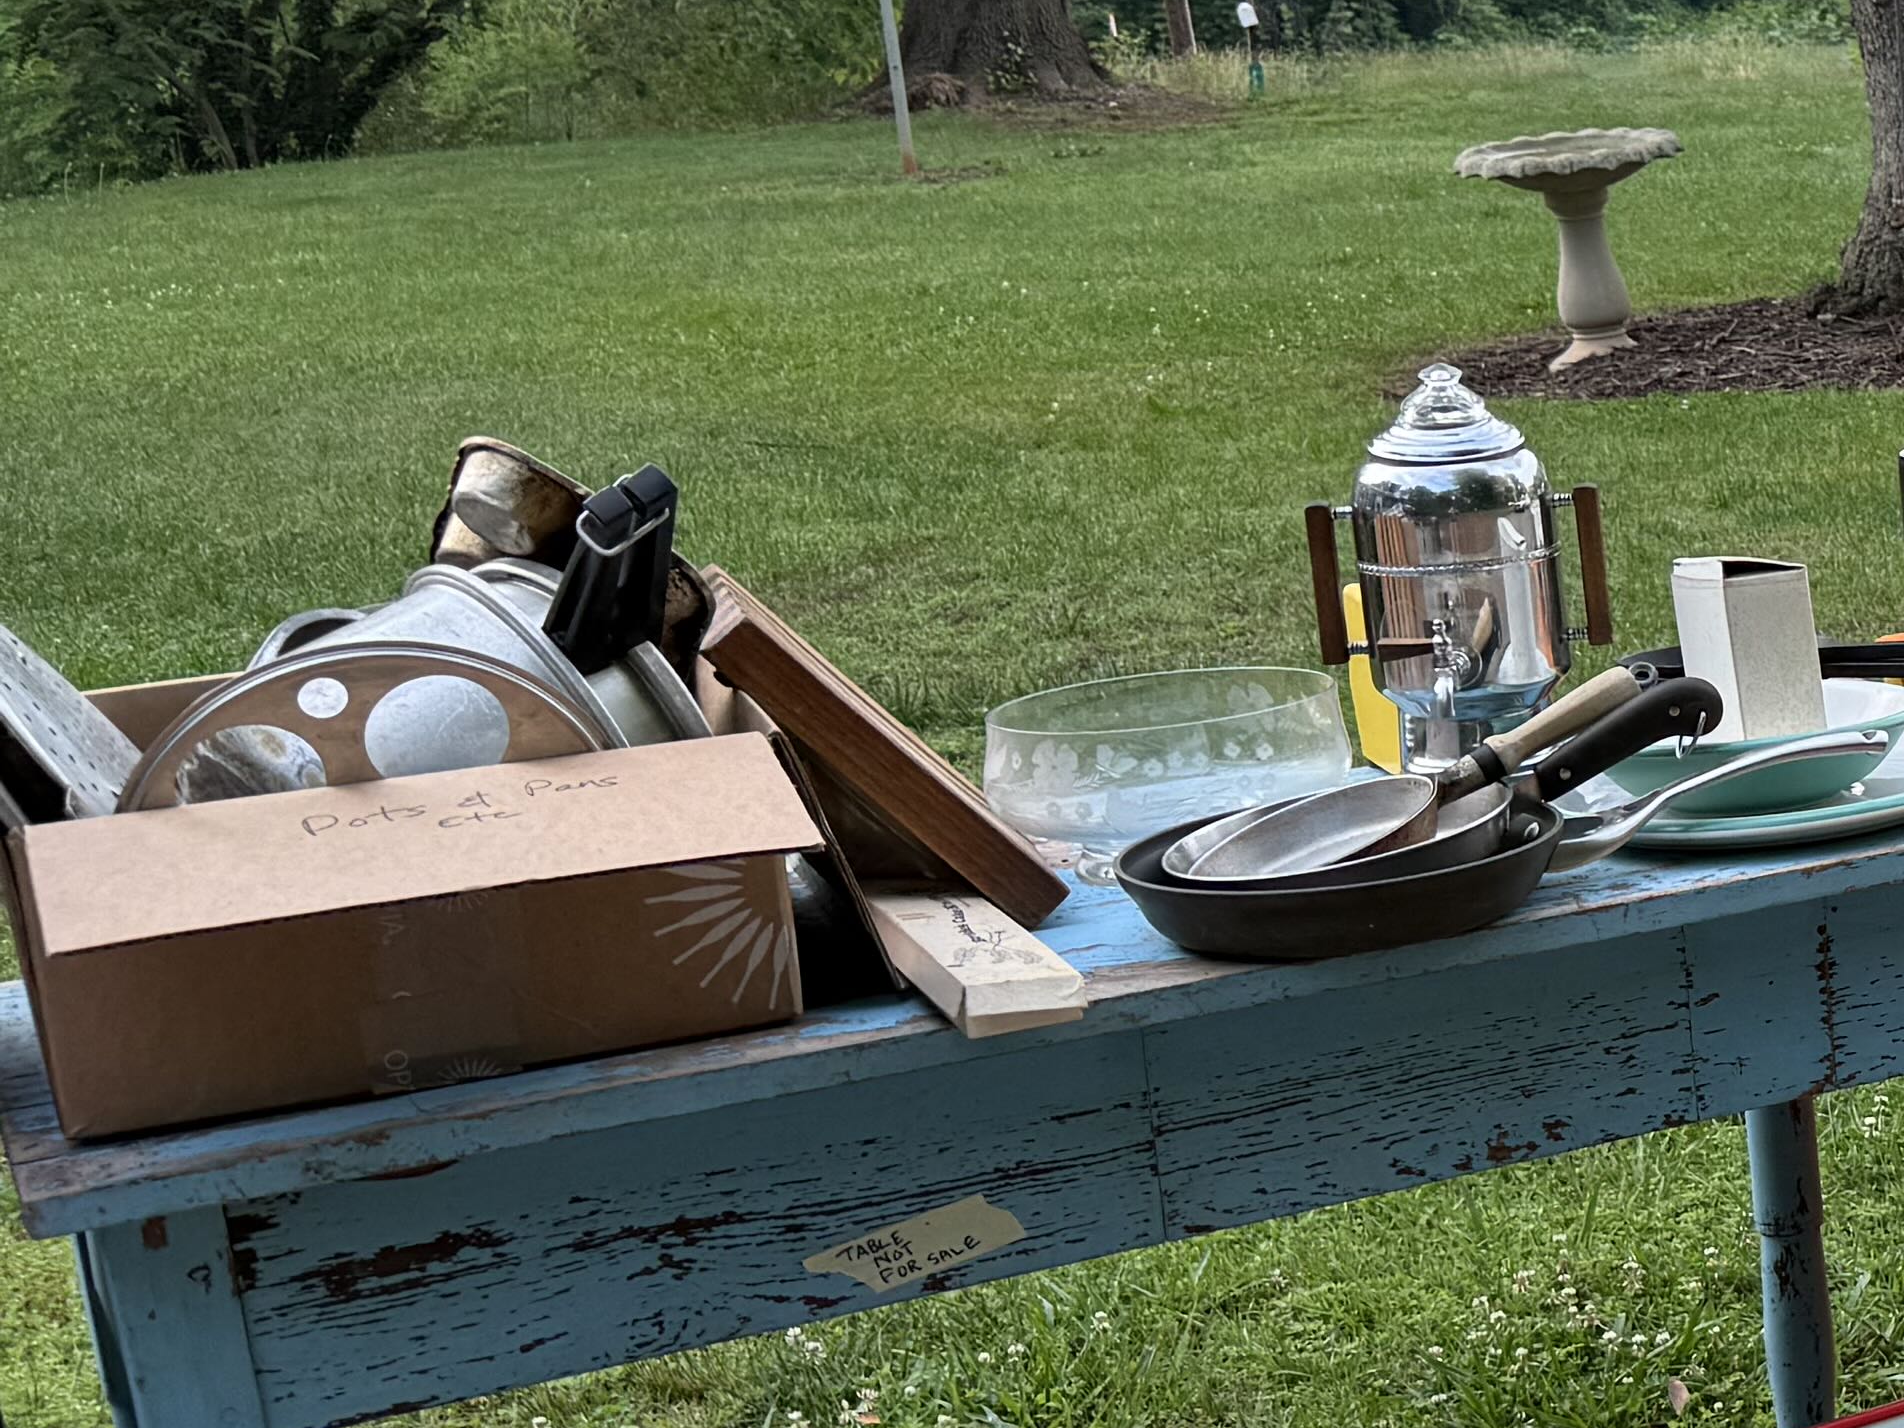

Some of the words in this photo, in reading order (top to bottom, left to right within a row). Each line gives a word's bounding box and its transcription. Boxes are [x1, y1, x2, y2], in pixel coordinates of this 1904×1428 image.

[301, 805, 427, 837] Pots
[524, 775, 619, 797] Pans
[437, 810, 524, 829] etc
[835, 1229, 905, 1262] TABLE
[872, 1240, 914, 1270] NOT
[878, 1258, 923, 1284] FOR
[926, 1234, 981, 1266] SALE
